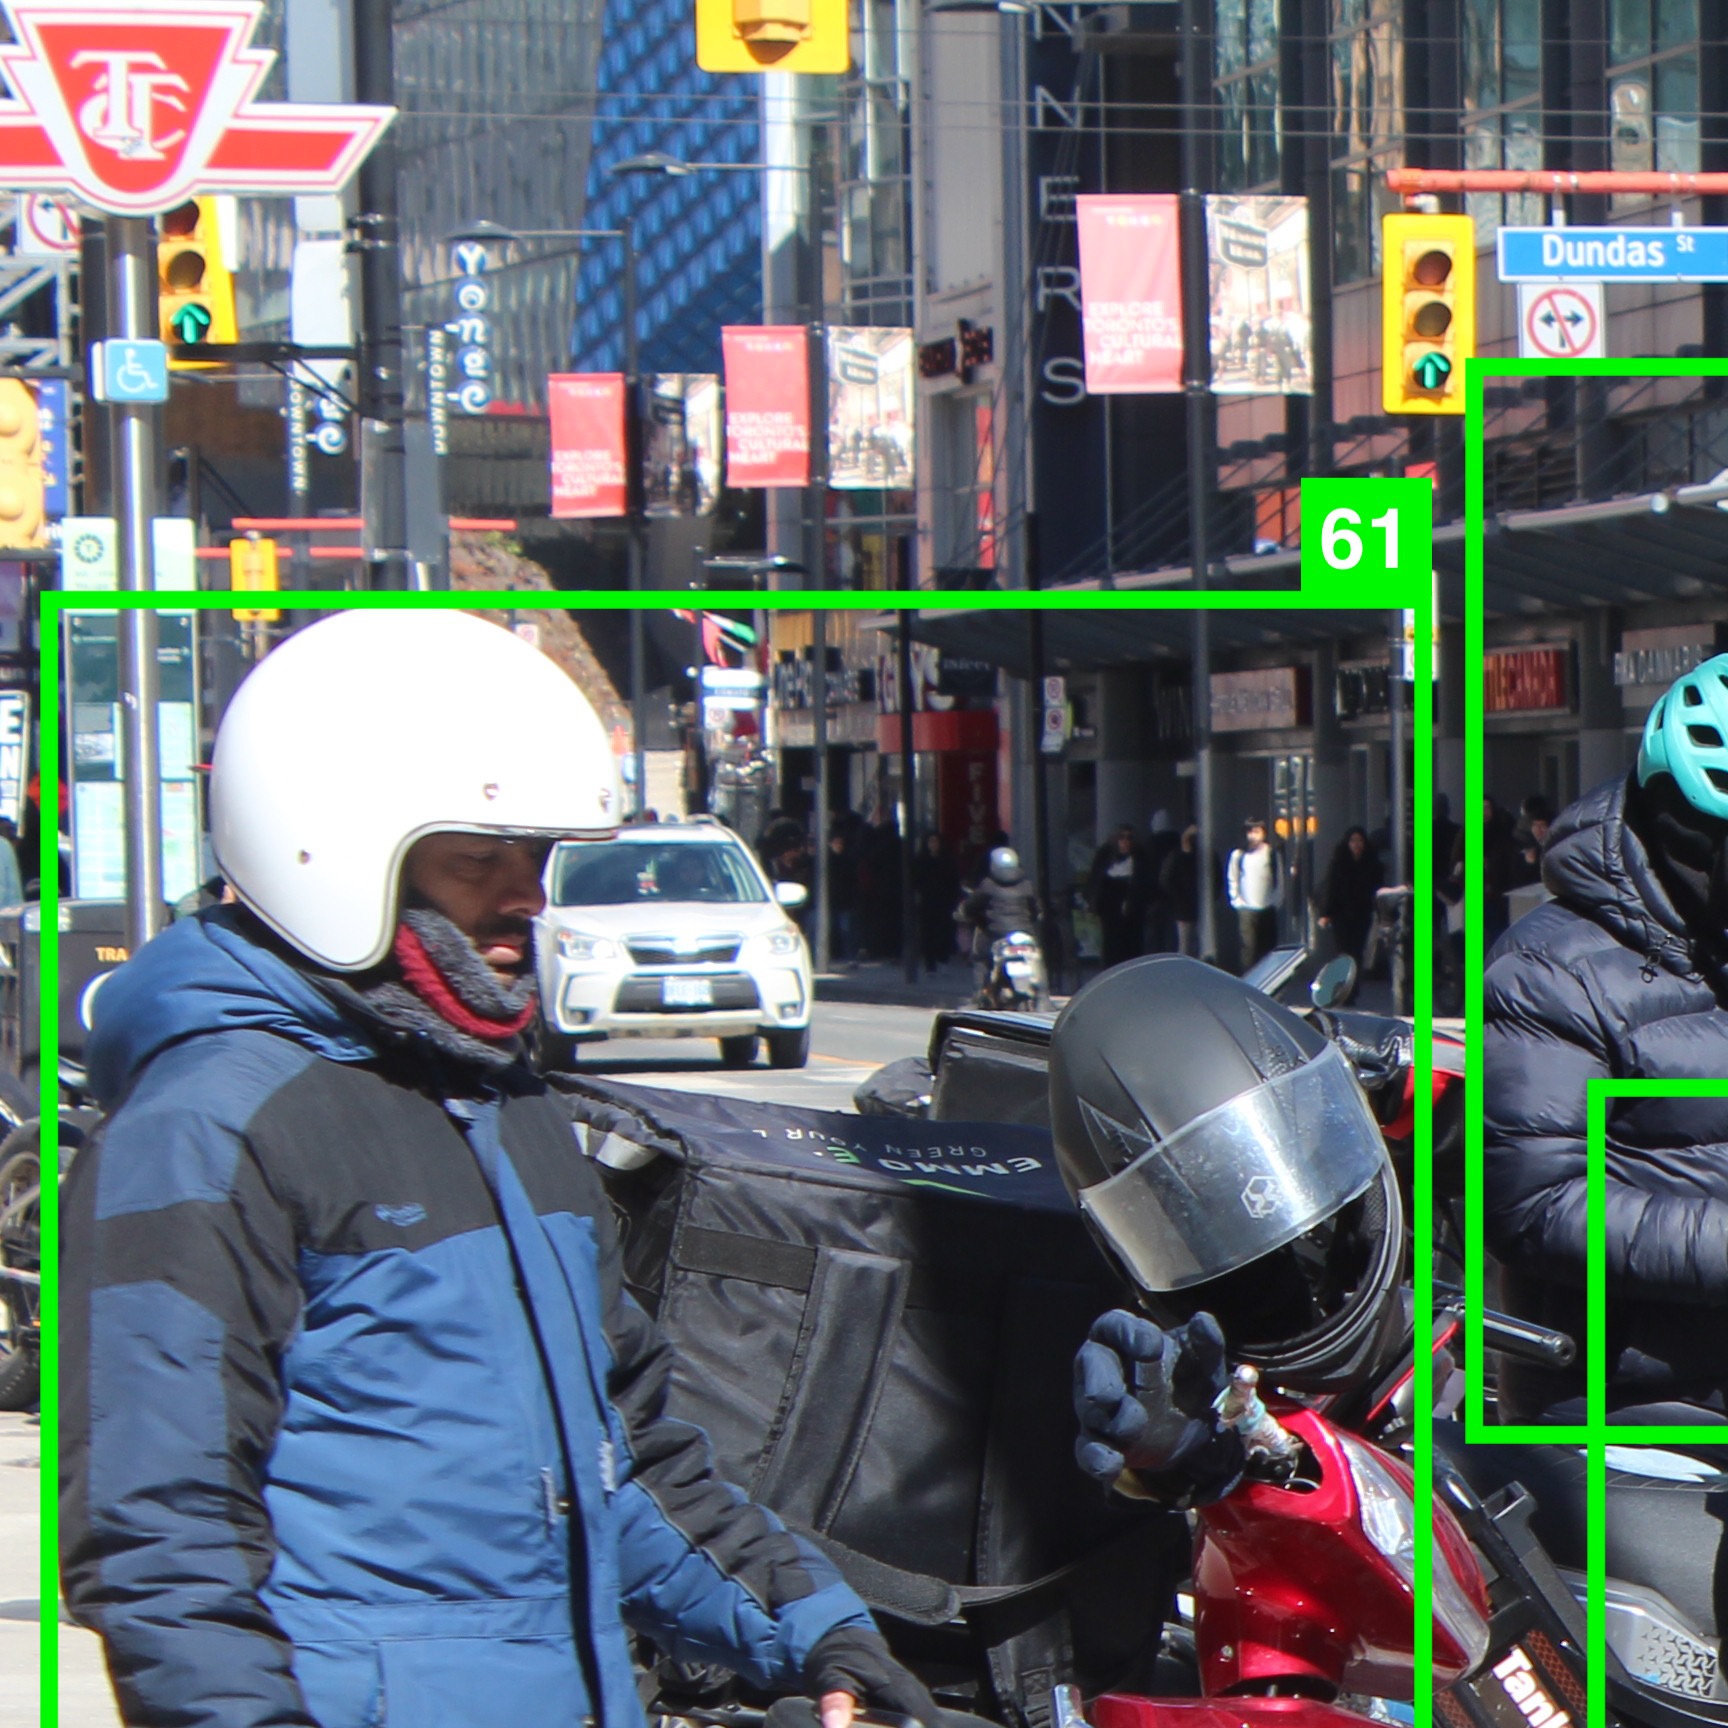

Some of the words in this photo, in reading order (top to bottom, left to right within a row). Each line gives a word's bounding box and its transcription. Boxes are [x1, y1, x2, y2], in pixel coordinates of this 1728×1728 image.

[1542, 234, 1666, 267] Dundas
[1676, 234, 1695, 252] St
[1088, 302, 1164, 318] EXPLORE
[1099, 334, 1182, 350] CULTURAL
[1089, 350, 1147, 366] HEART
[729, 412, 793, 425] EXPLORE
[738, 438, 809, 451] CULTURAL
[729, 452, 778, 465] HEART
[885, 1144, 988, 1159] GREEN
